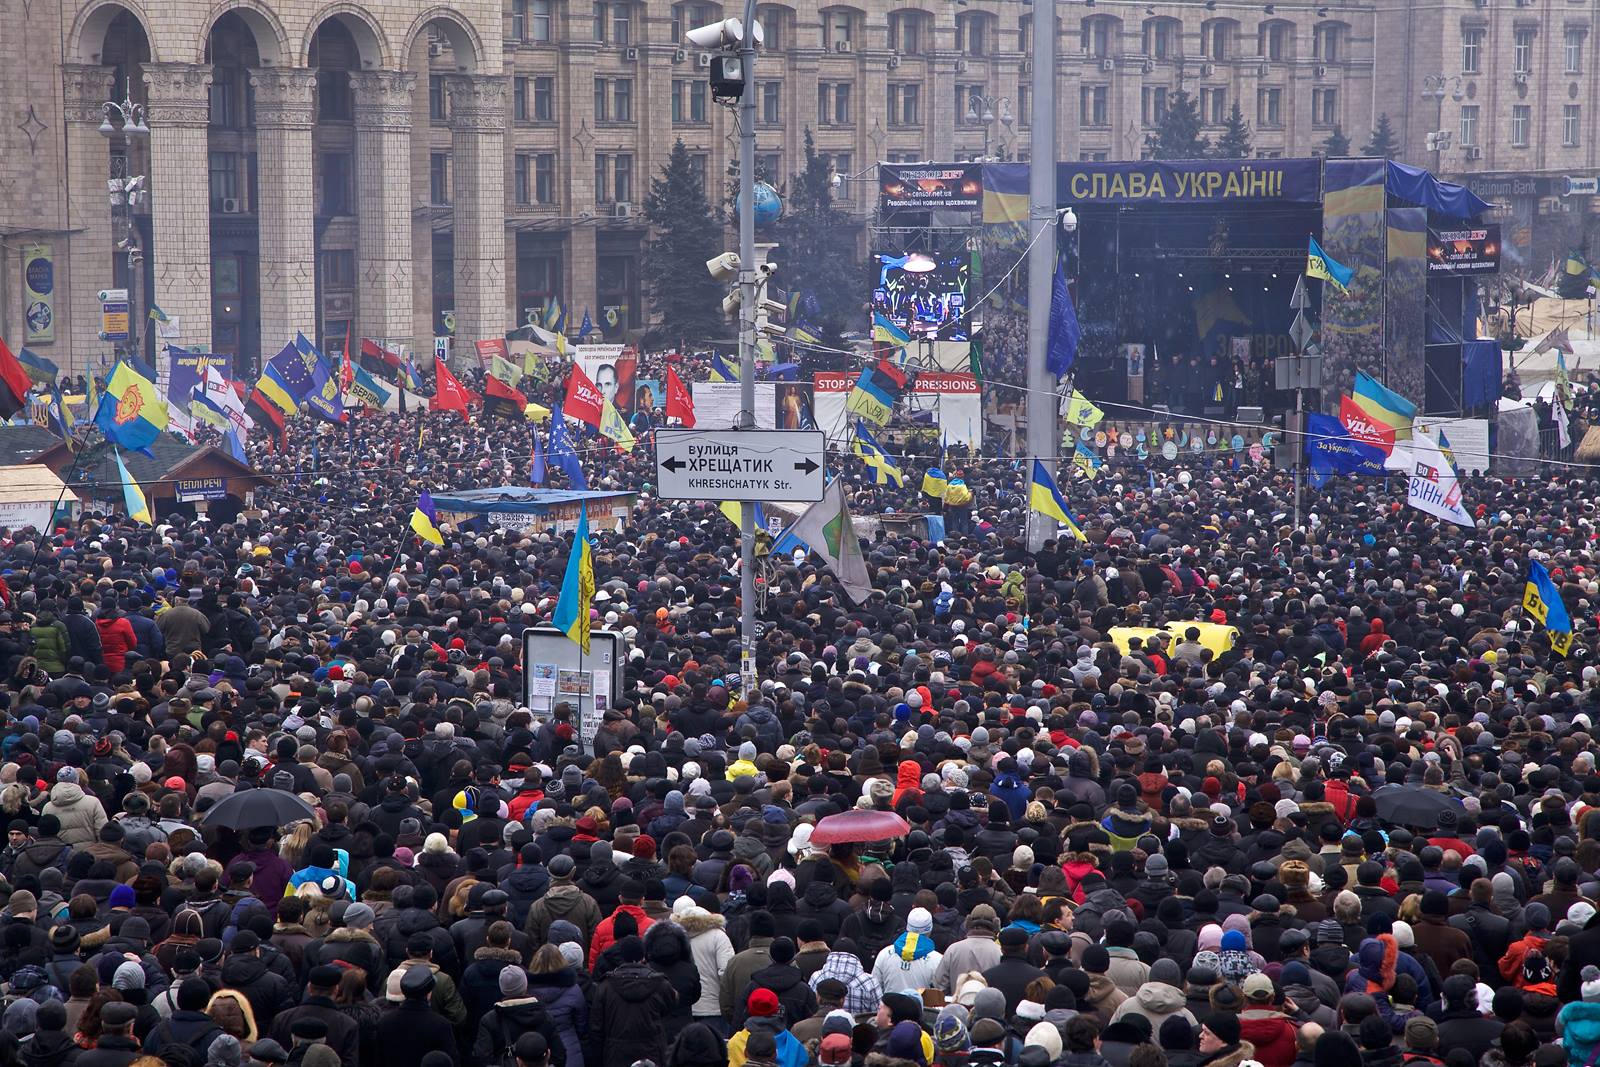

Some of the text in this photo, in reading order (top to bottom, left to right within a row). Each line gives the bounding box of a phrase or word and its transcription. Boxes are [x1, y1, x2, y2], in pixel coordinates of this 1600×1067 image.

[1071, 166, 1283, 199] СЛАВА УКРАЇНІ!
[1471, 179, 1537, 196] Platinum Bank
[818, 379, 845, 389] STOP
[915, 380, 977, 390] PRESSIONS
[688, 458, 774, 474] ХРЕЩАТИК
[178, 478, 222, 490] ТЕПЛІ РЕЧІ
[688, 478, 792, 490] KHRESHCHATYK Str.
